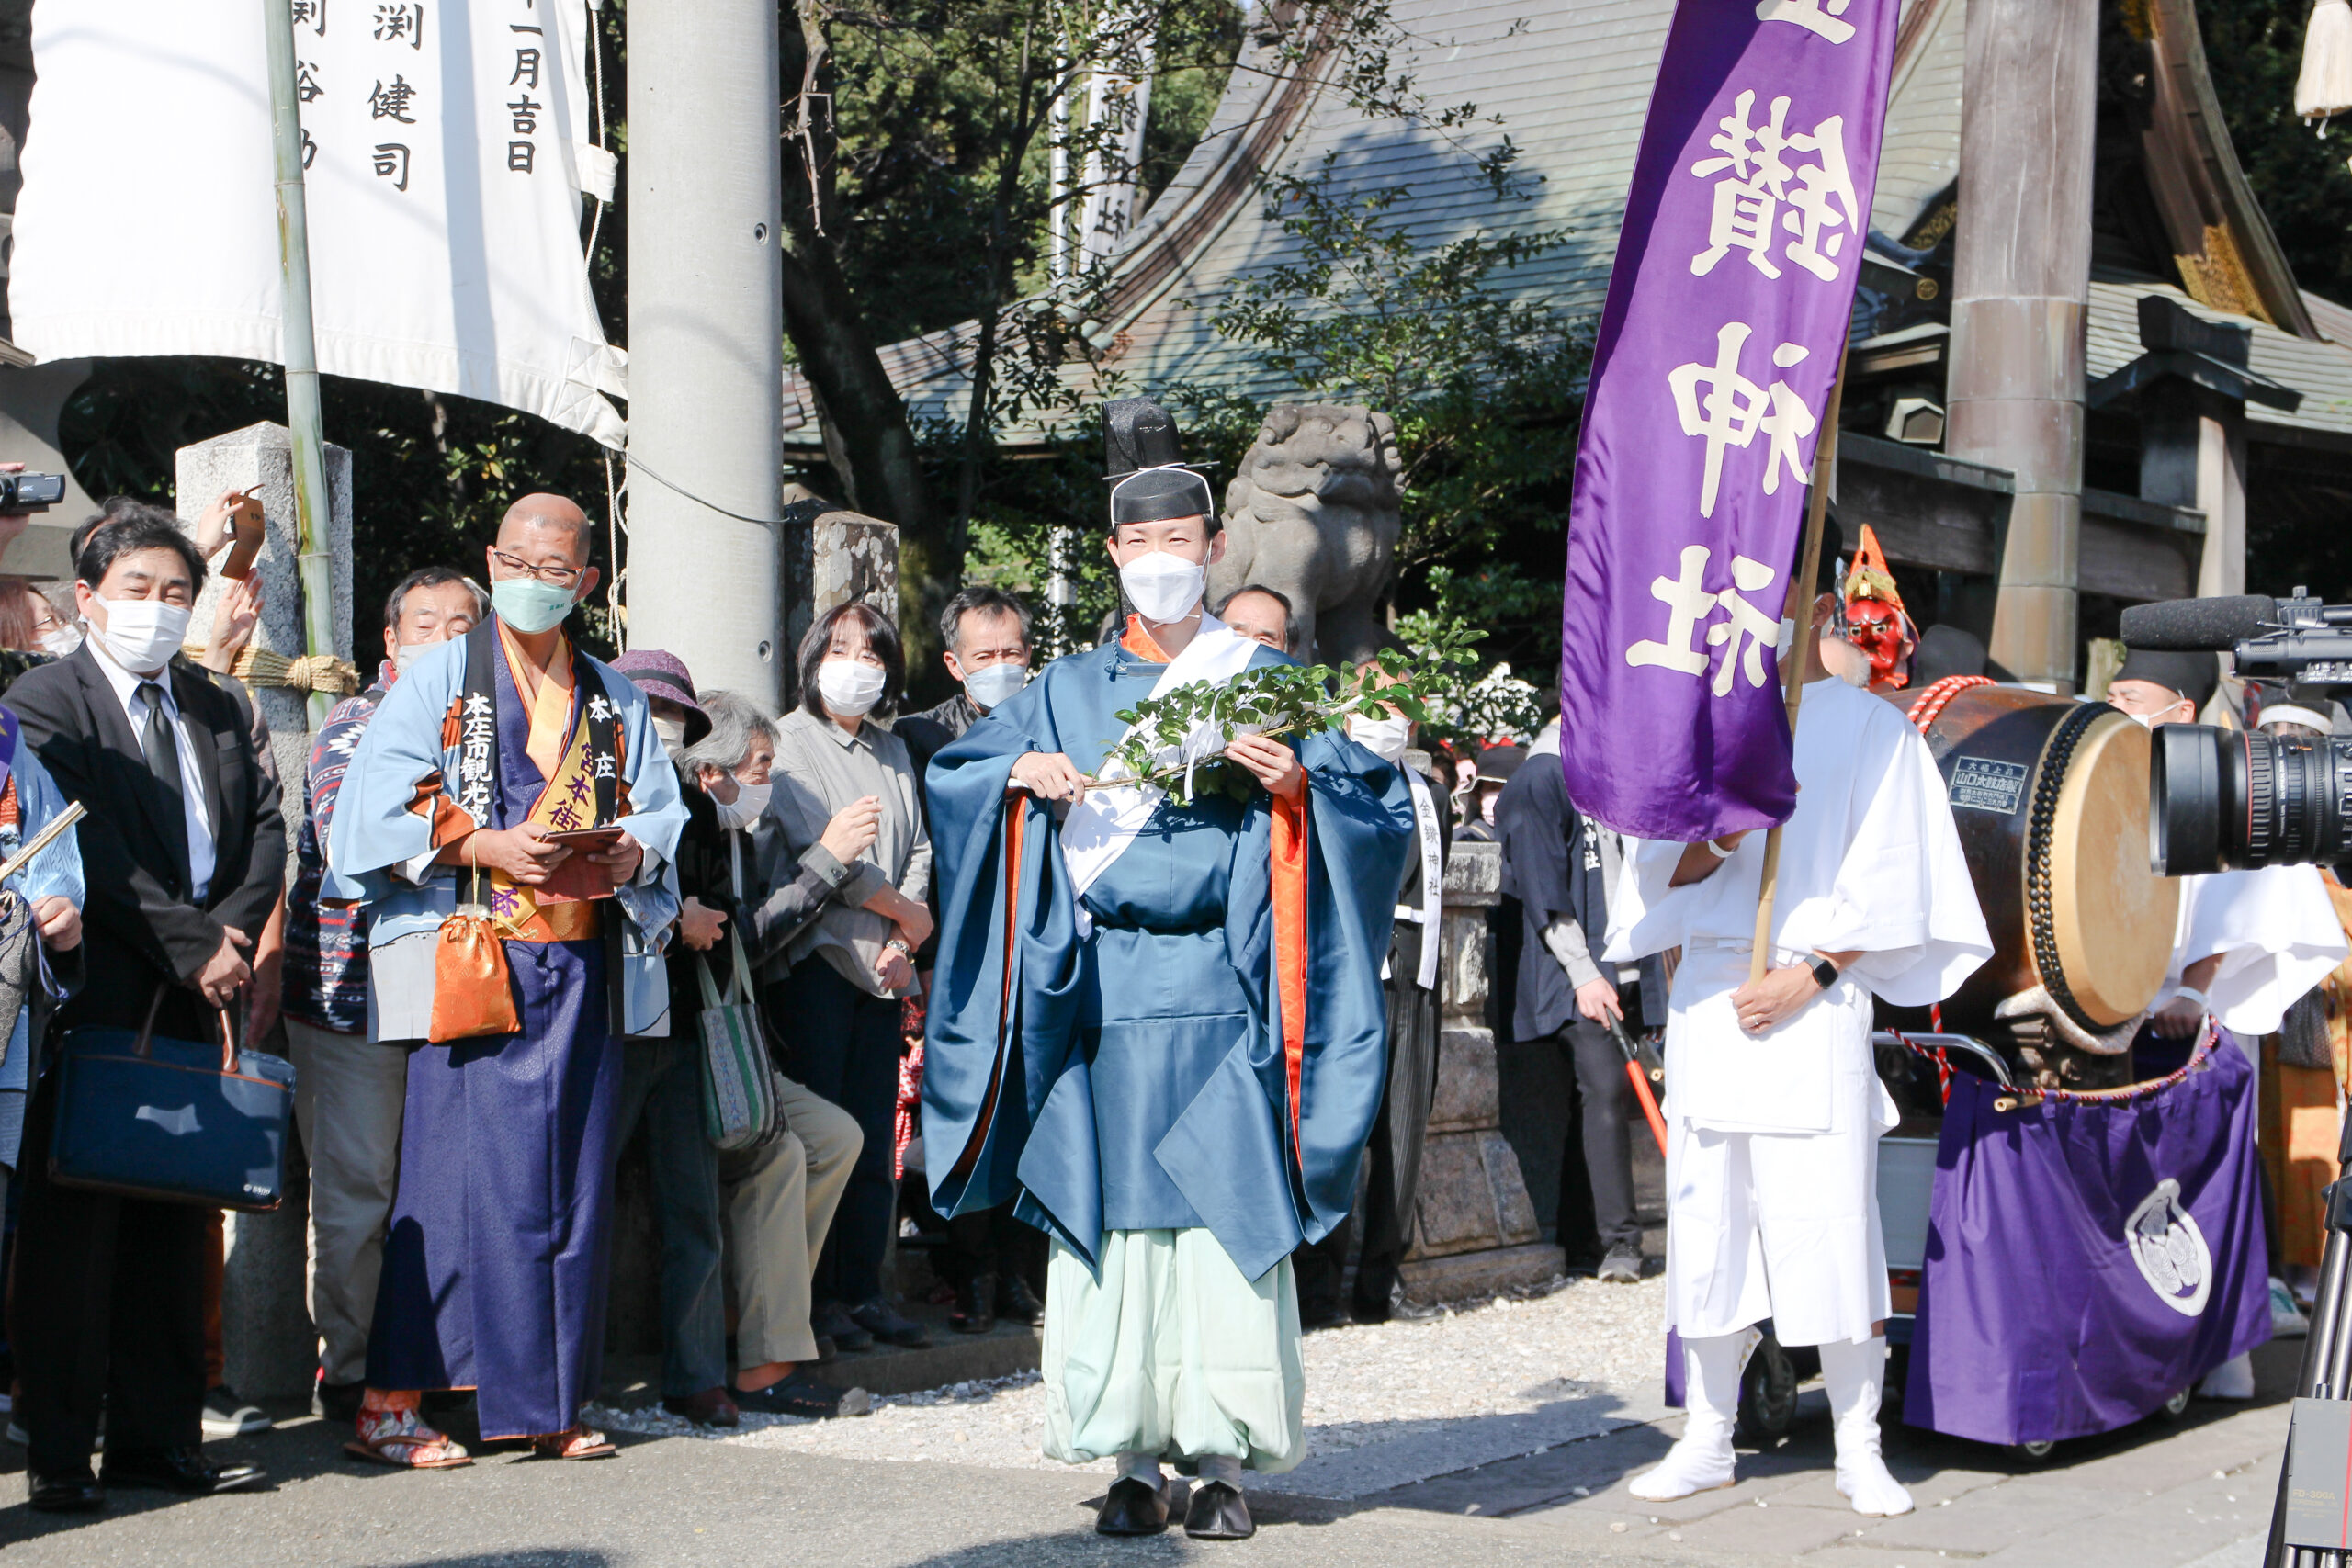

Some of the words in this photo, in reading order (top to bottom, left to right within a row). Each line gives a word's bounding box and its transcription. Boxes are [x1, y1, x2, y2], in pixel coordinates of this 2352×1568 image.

[506, 0, 544, 175] 一月吉日
[589, 693, 617, 828] 本庄
